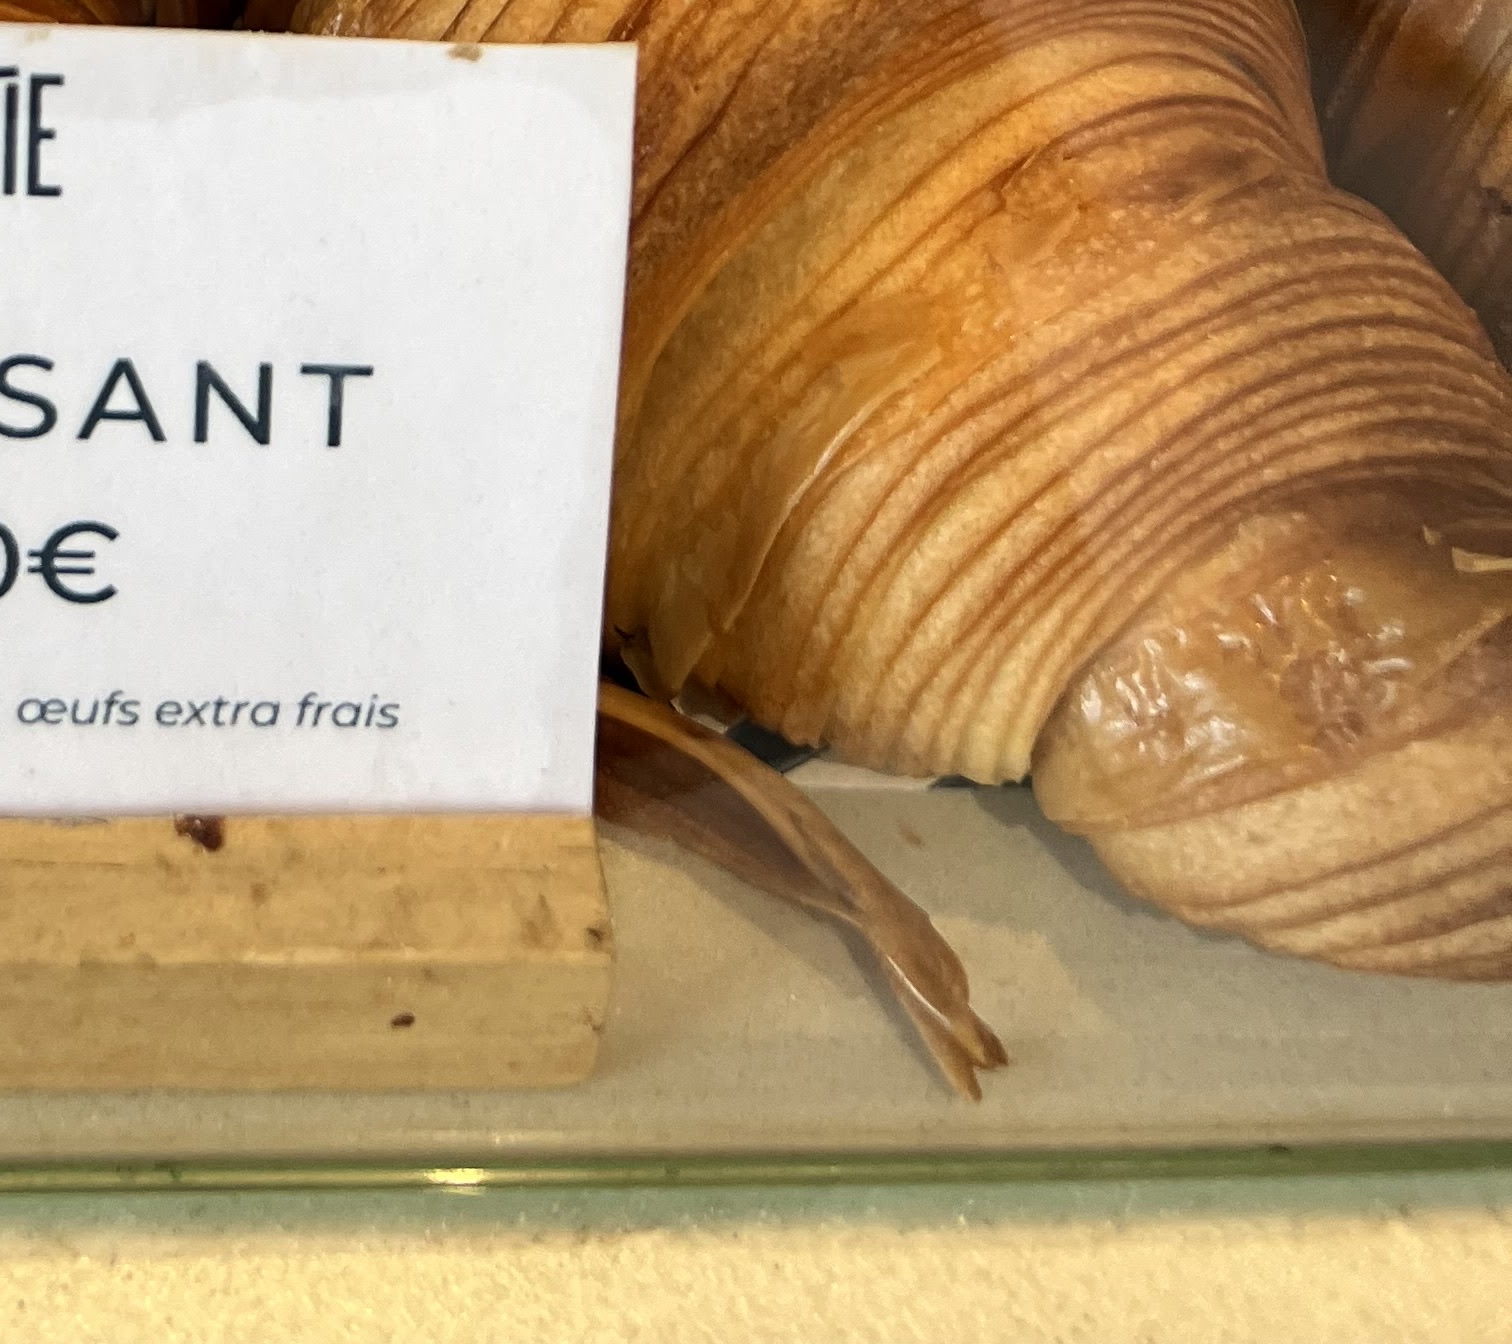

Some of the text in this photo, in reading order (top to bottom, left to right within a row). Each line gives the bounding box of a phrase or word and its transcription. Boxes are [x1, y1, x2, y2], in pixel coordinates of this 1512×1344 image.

[16, 689, 142, 728] œufs
[154, 694, 282, 730] extra
[294, 691, 401, 730] frais
